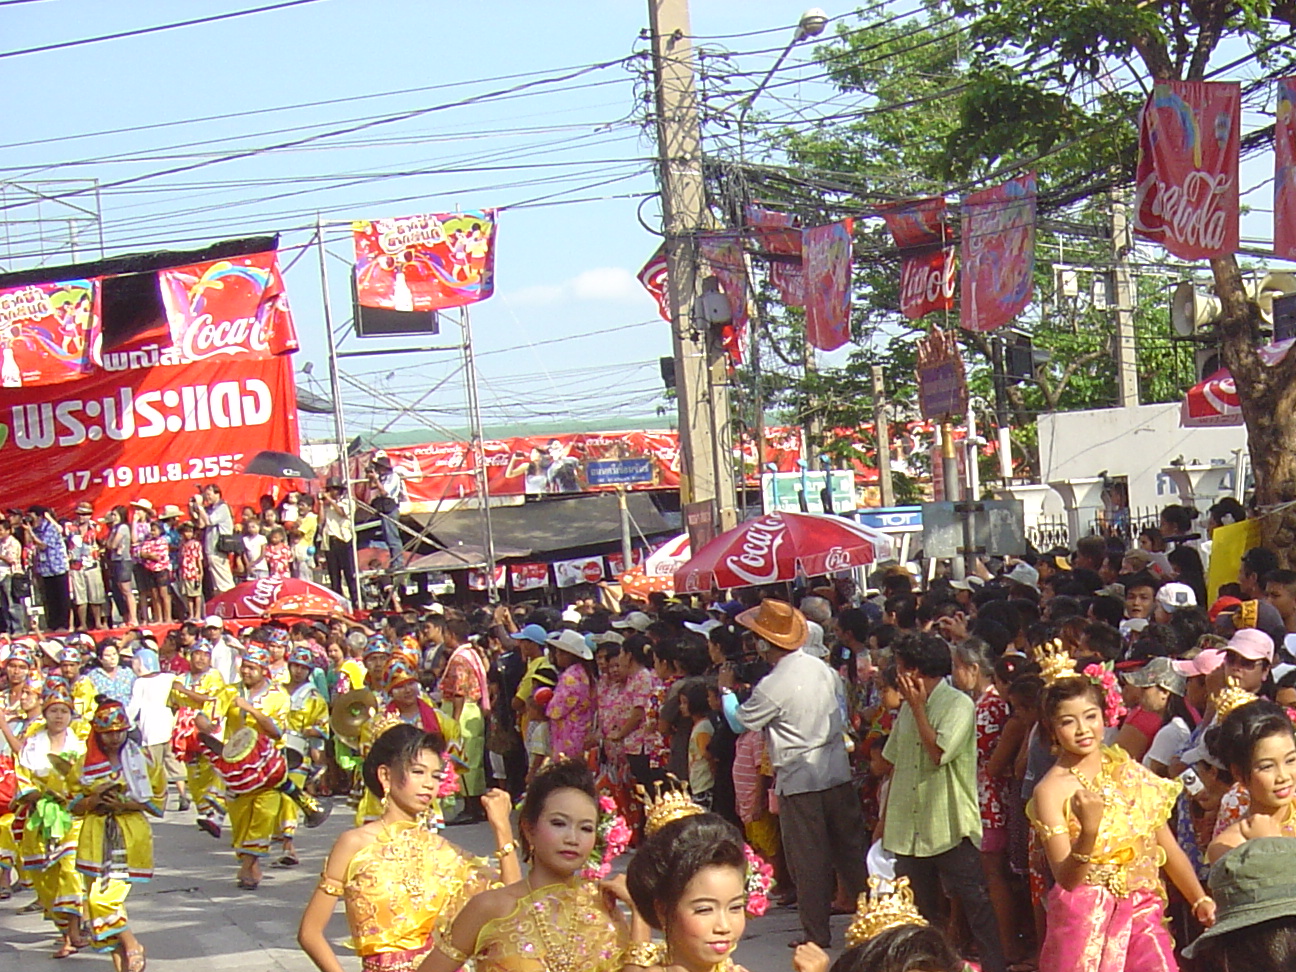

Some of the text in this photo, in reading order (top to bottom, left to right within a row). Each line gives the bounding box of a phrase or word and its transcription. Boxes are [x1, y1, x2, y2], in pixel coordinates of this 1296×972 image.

[11, 378, 273, 451] พระประแดง
[63, 469, 134, 492] 17-19
[876, 514, 919, 526] TOT
